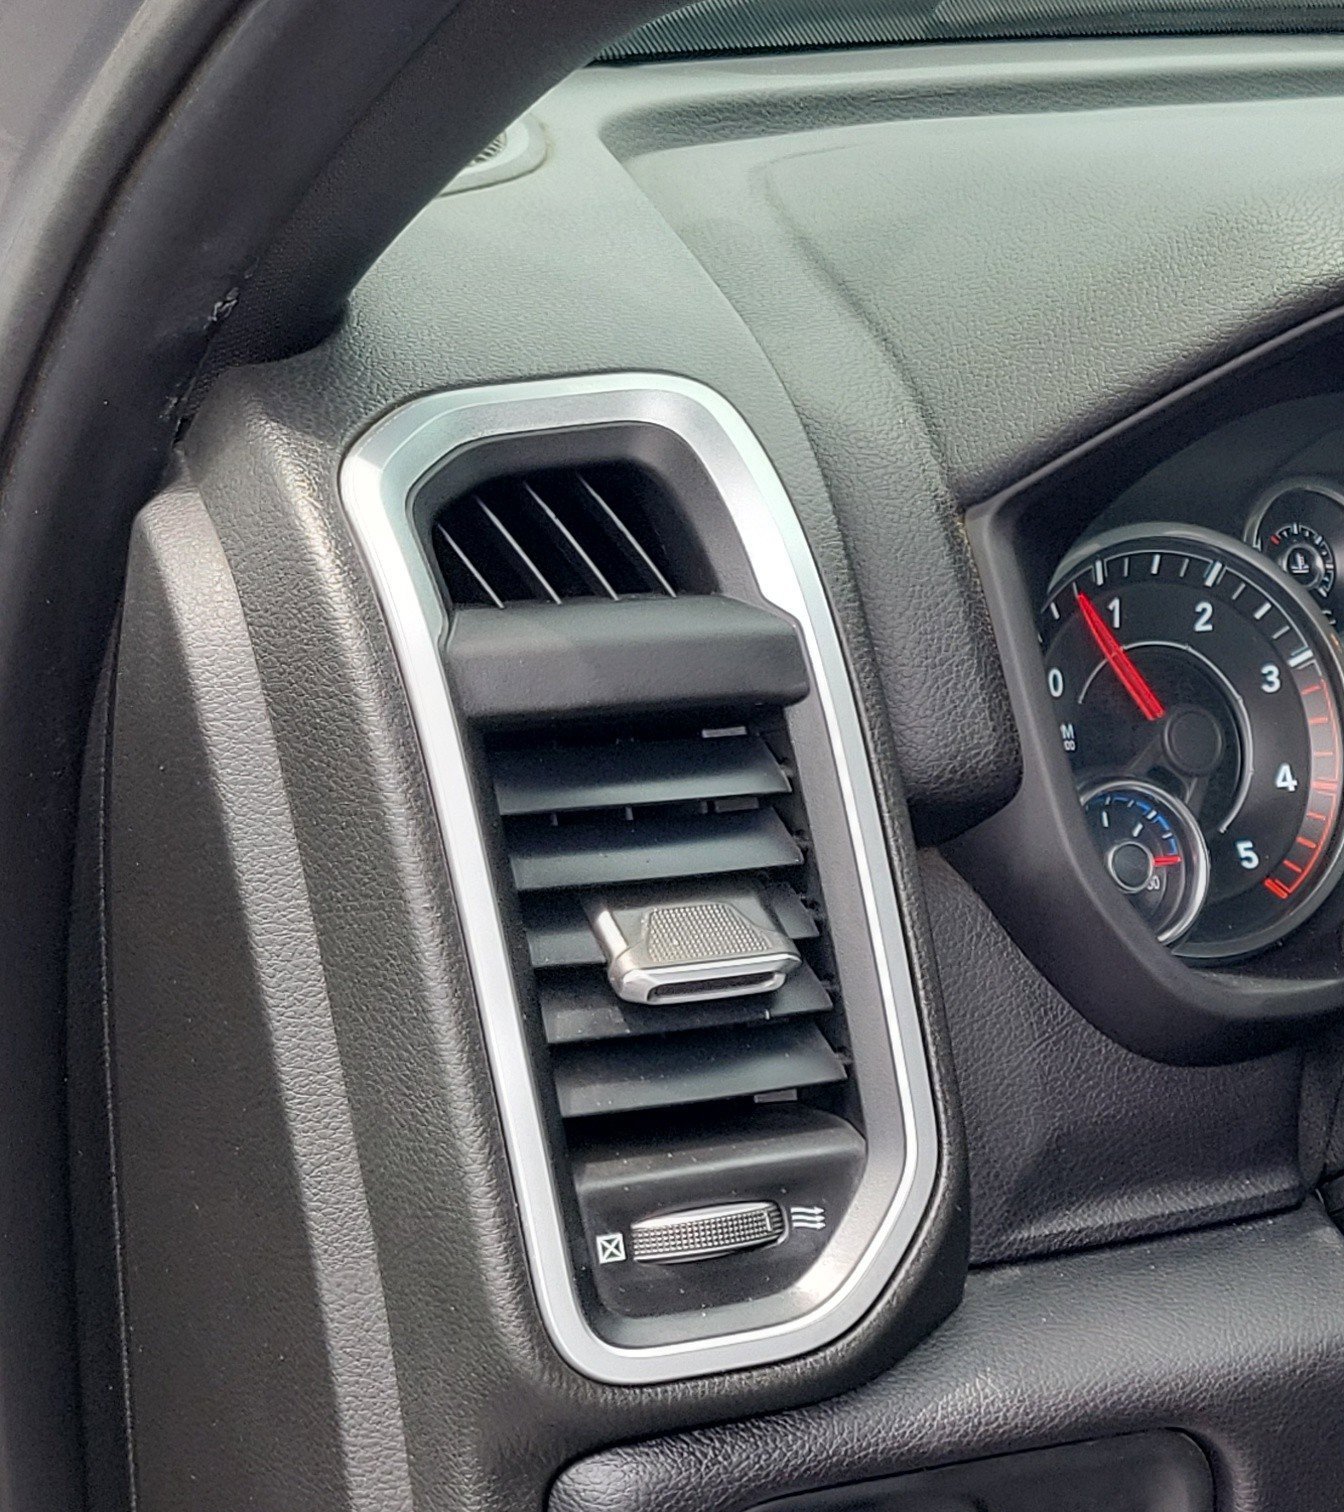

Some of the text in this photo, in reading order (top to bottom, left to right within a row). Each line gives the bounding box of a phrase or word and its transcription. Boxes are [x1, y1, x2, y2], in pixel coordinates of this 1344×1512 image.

[1108, 597, 1121, 628] 1
[1194, 601, 1213, 632] 2
[1049, 668, 1063, 697] 0
[1261, 664, 1281, 693] 3
[1276, 763, 1297, 792] 4
[1236, 840, 1259, 869] 5
